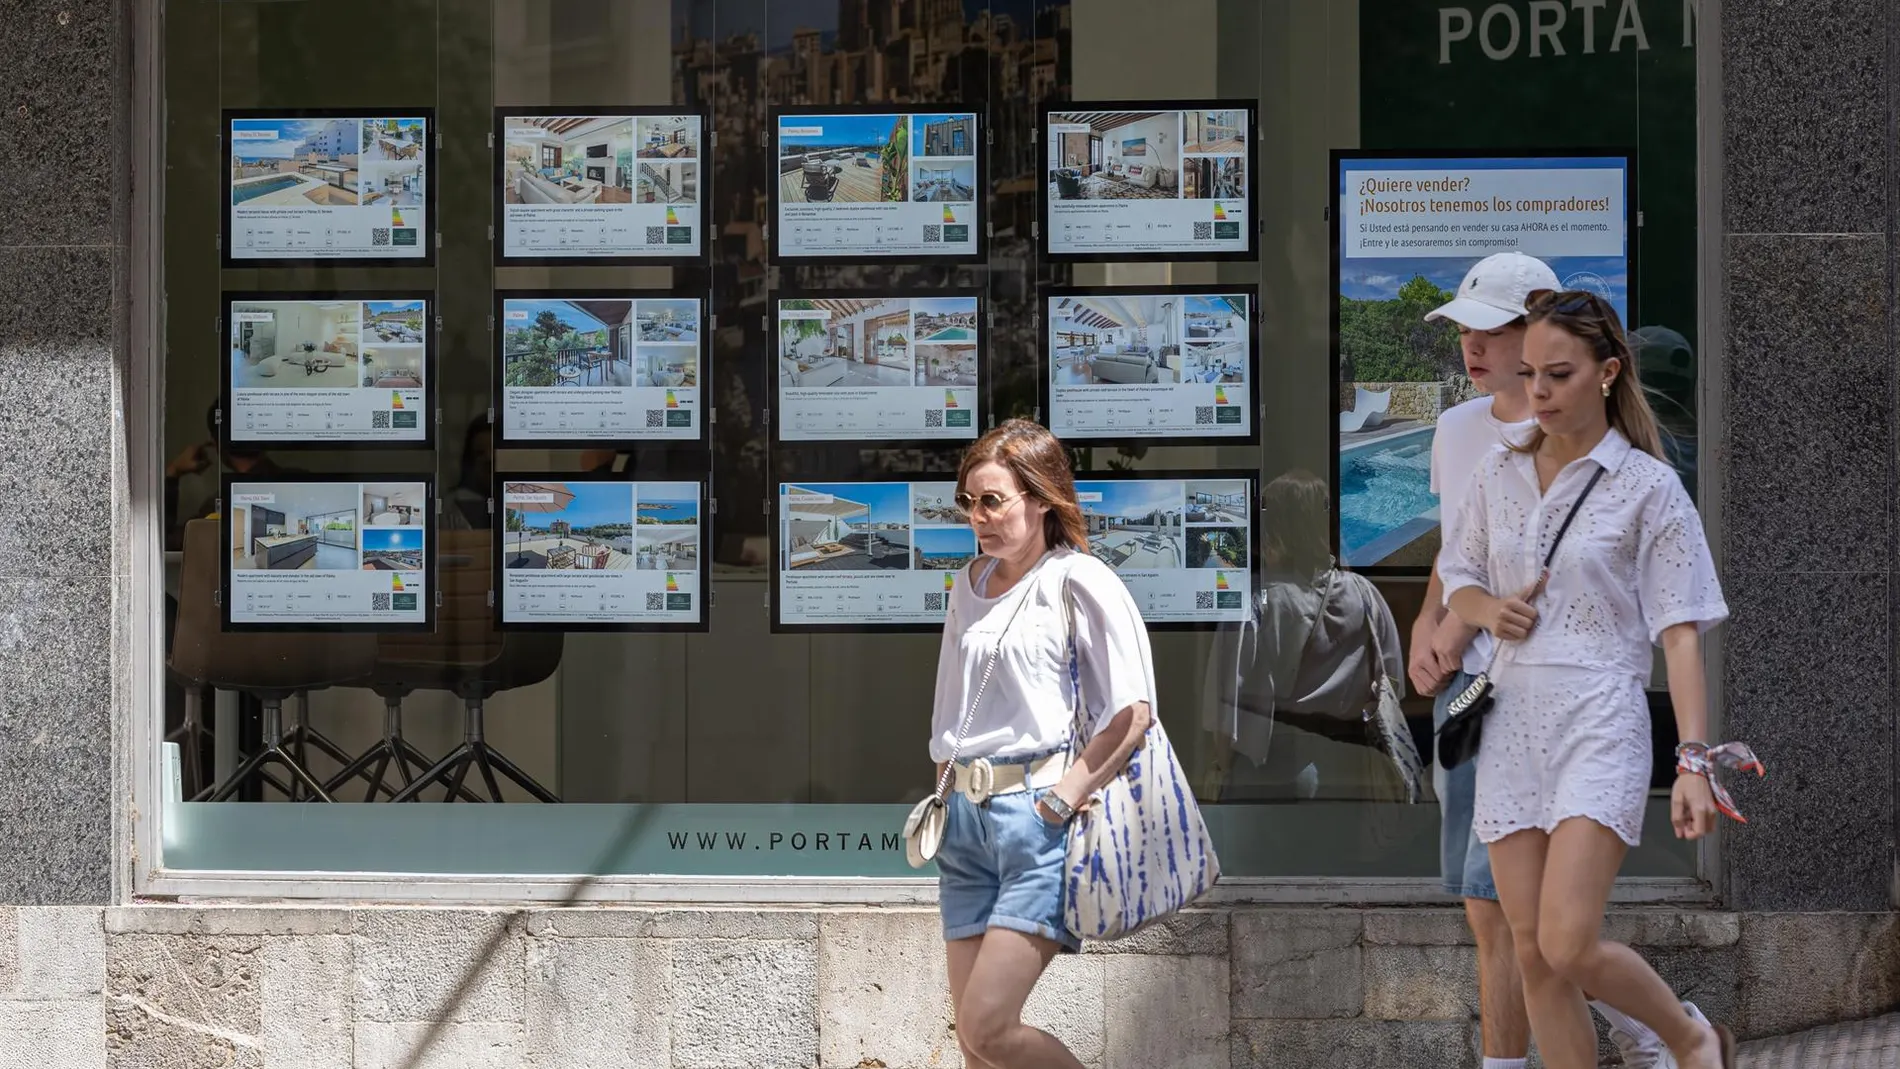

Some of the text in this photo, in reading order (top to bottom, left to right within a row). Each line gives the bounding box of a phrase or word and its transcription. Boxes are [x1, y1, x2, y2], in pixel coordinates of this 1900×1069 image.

[1438, 0, 1650, 64] PORTA
[1360, 176, 1470, 195] ¿Quiere vender?
[1360, 196, 1609, 216] ¡Nosotros tenemos los compradores!
[1360, 223, 1367, 232] Si
[1369, 223, 1391, 232] Usted
[1393, 223, 1409, 232] está
[1412, 223, 1449, 234] pensando
[1462, 223, 1489, 232] vender
[1520, 222, 1549, 231] AHORA
[1561, 222, 1569, 231] el
[1570, 223, 1610, 231] momento.
[1360, 238, 1518, 248] ¡Entre y le asesoraremos sin compromiso!
